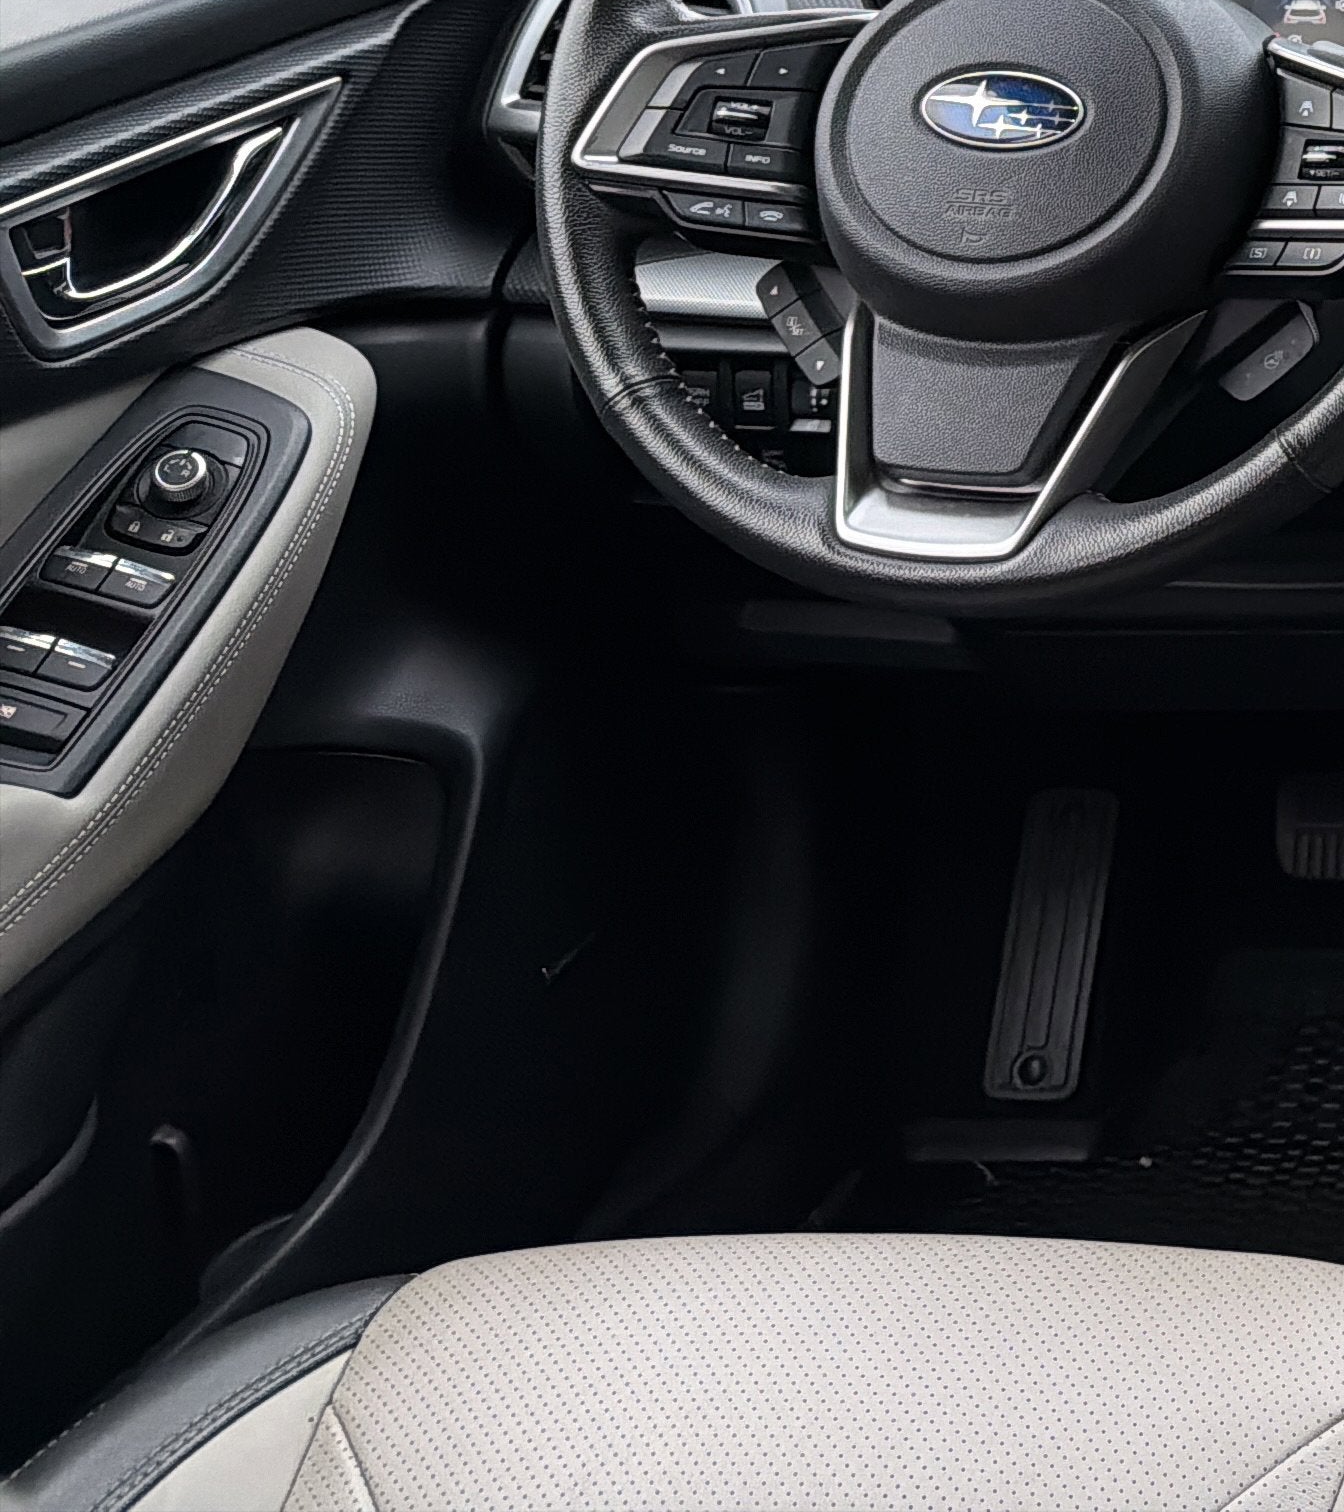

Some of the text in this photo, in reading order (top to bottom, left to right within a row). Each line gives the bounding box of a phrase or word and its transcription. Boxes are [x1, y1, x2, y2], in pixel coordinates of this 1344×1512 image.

[667, 143, 708, 156] Source
[744, 154, 771, 165] INFO
[66, 562, 88, 576] AUTO
[125, 579, 146, 592] AUTO
